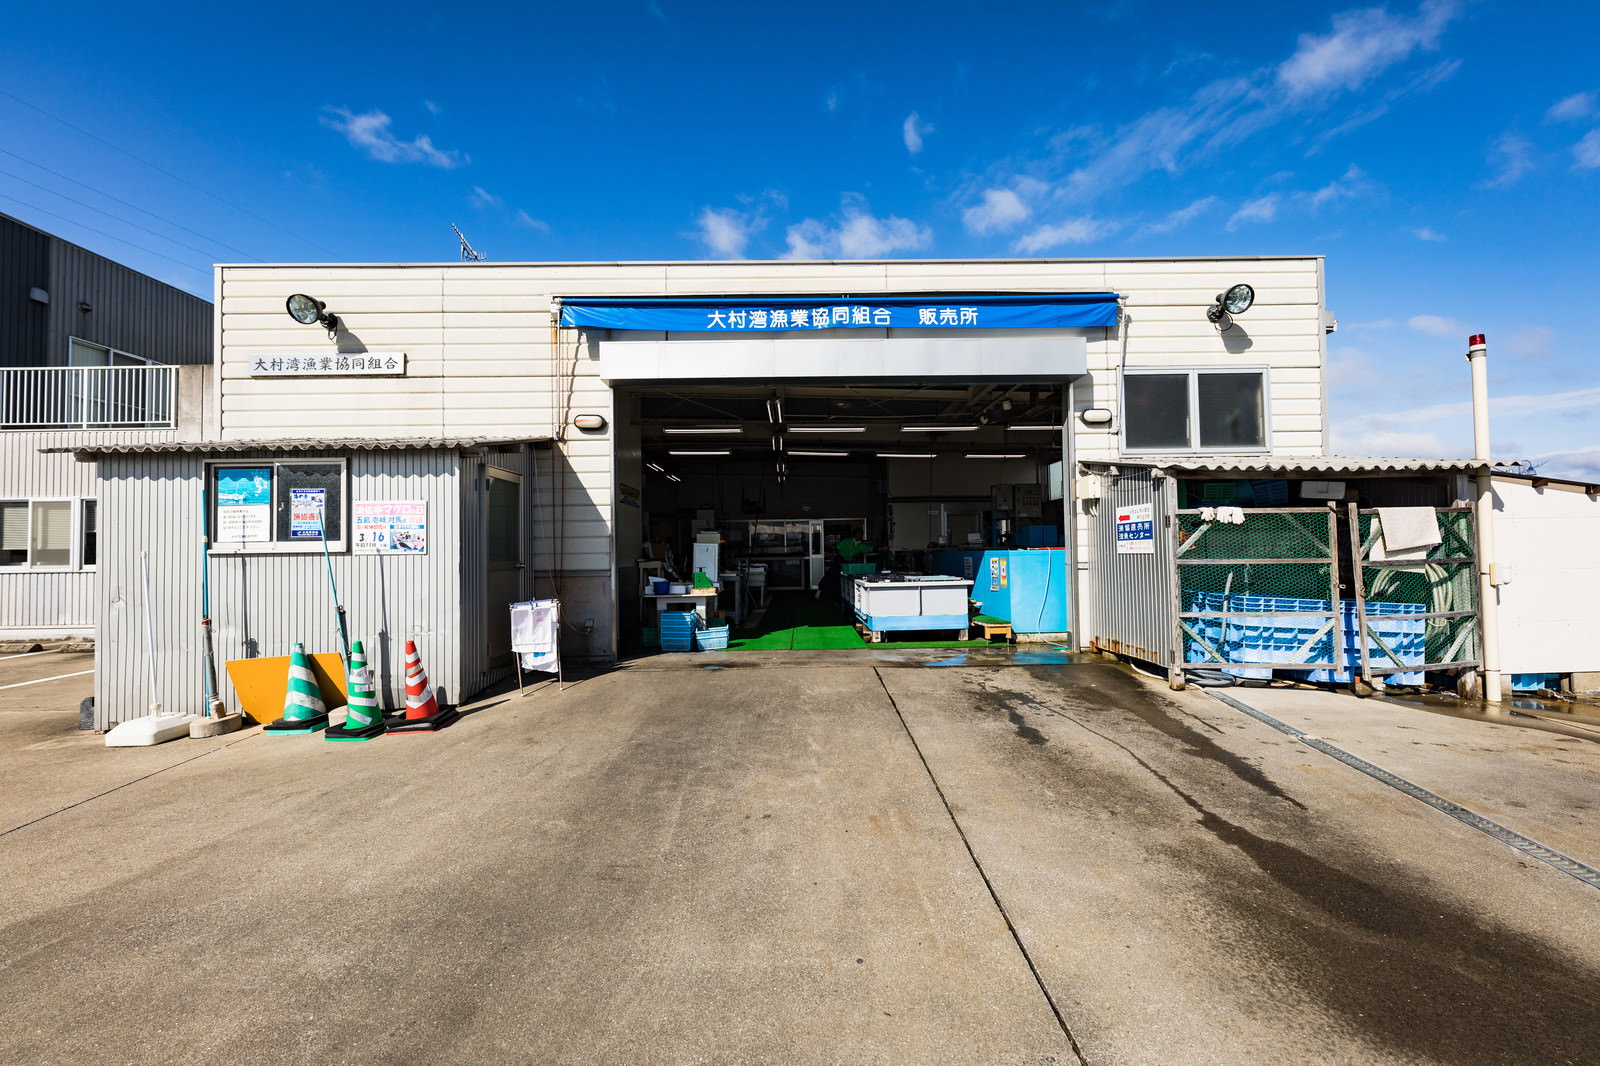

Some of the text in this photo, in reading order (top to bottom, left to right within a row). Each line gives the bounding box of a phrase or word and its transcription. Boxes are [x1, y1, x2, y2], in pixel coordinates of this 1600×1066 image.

[707, 306, 979, 329] 大村湾漁業協同組合 販売所
[254, 356, 398, 371] 大村湾漁業協同組合
